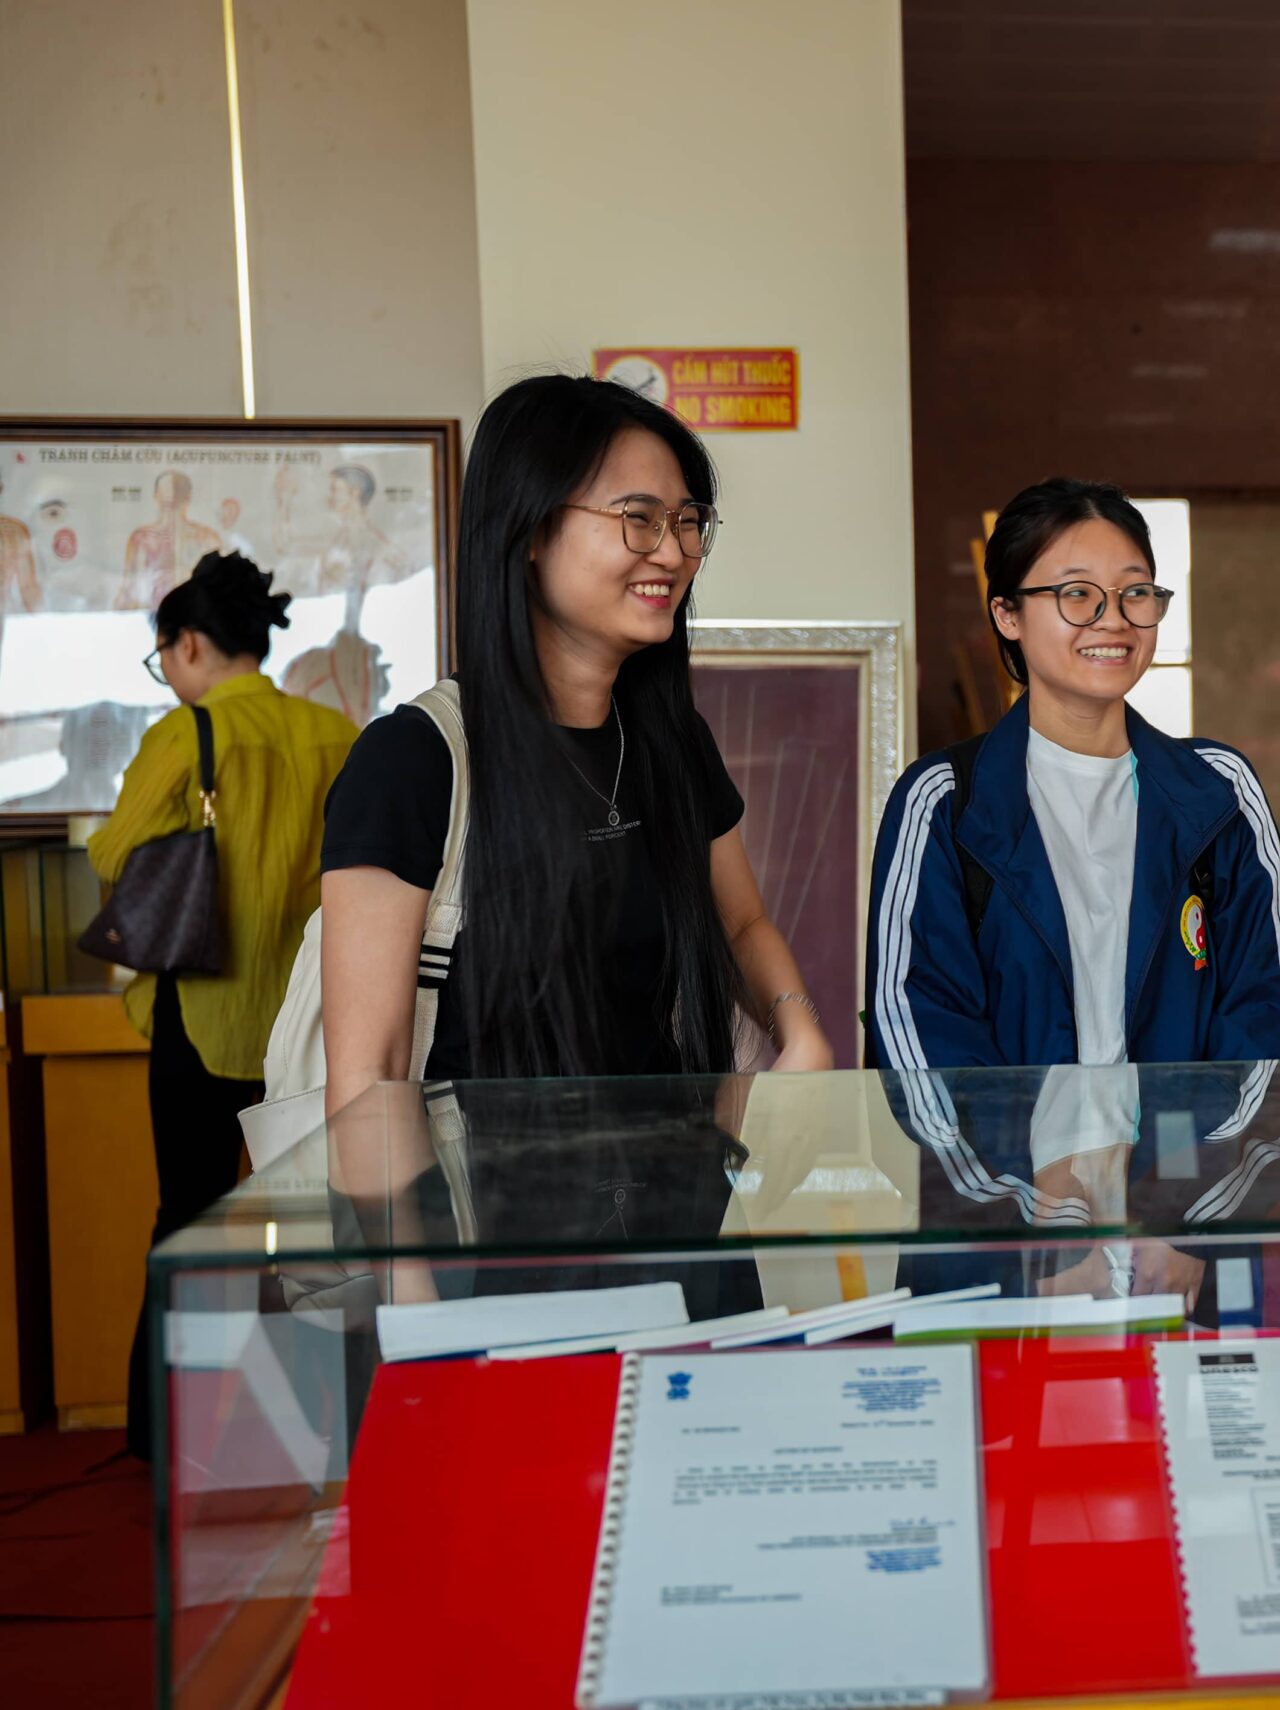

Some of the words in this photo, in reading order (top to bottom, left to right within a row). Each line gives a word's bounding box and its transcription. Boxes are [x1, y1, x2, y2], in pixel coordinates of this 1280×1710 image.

[672, 353, 707, 385] CẤM
[711, 356, 740, 385] HÚT
[743, 353, 791, 385] THUỐC
[674, 396, 700, 423] NO
[705, 395, 791, 423] SMOKING
[39, 448, 89, 463] TRANH
